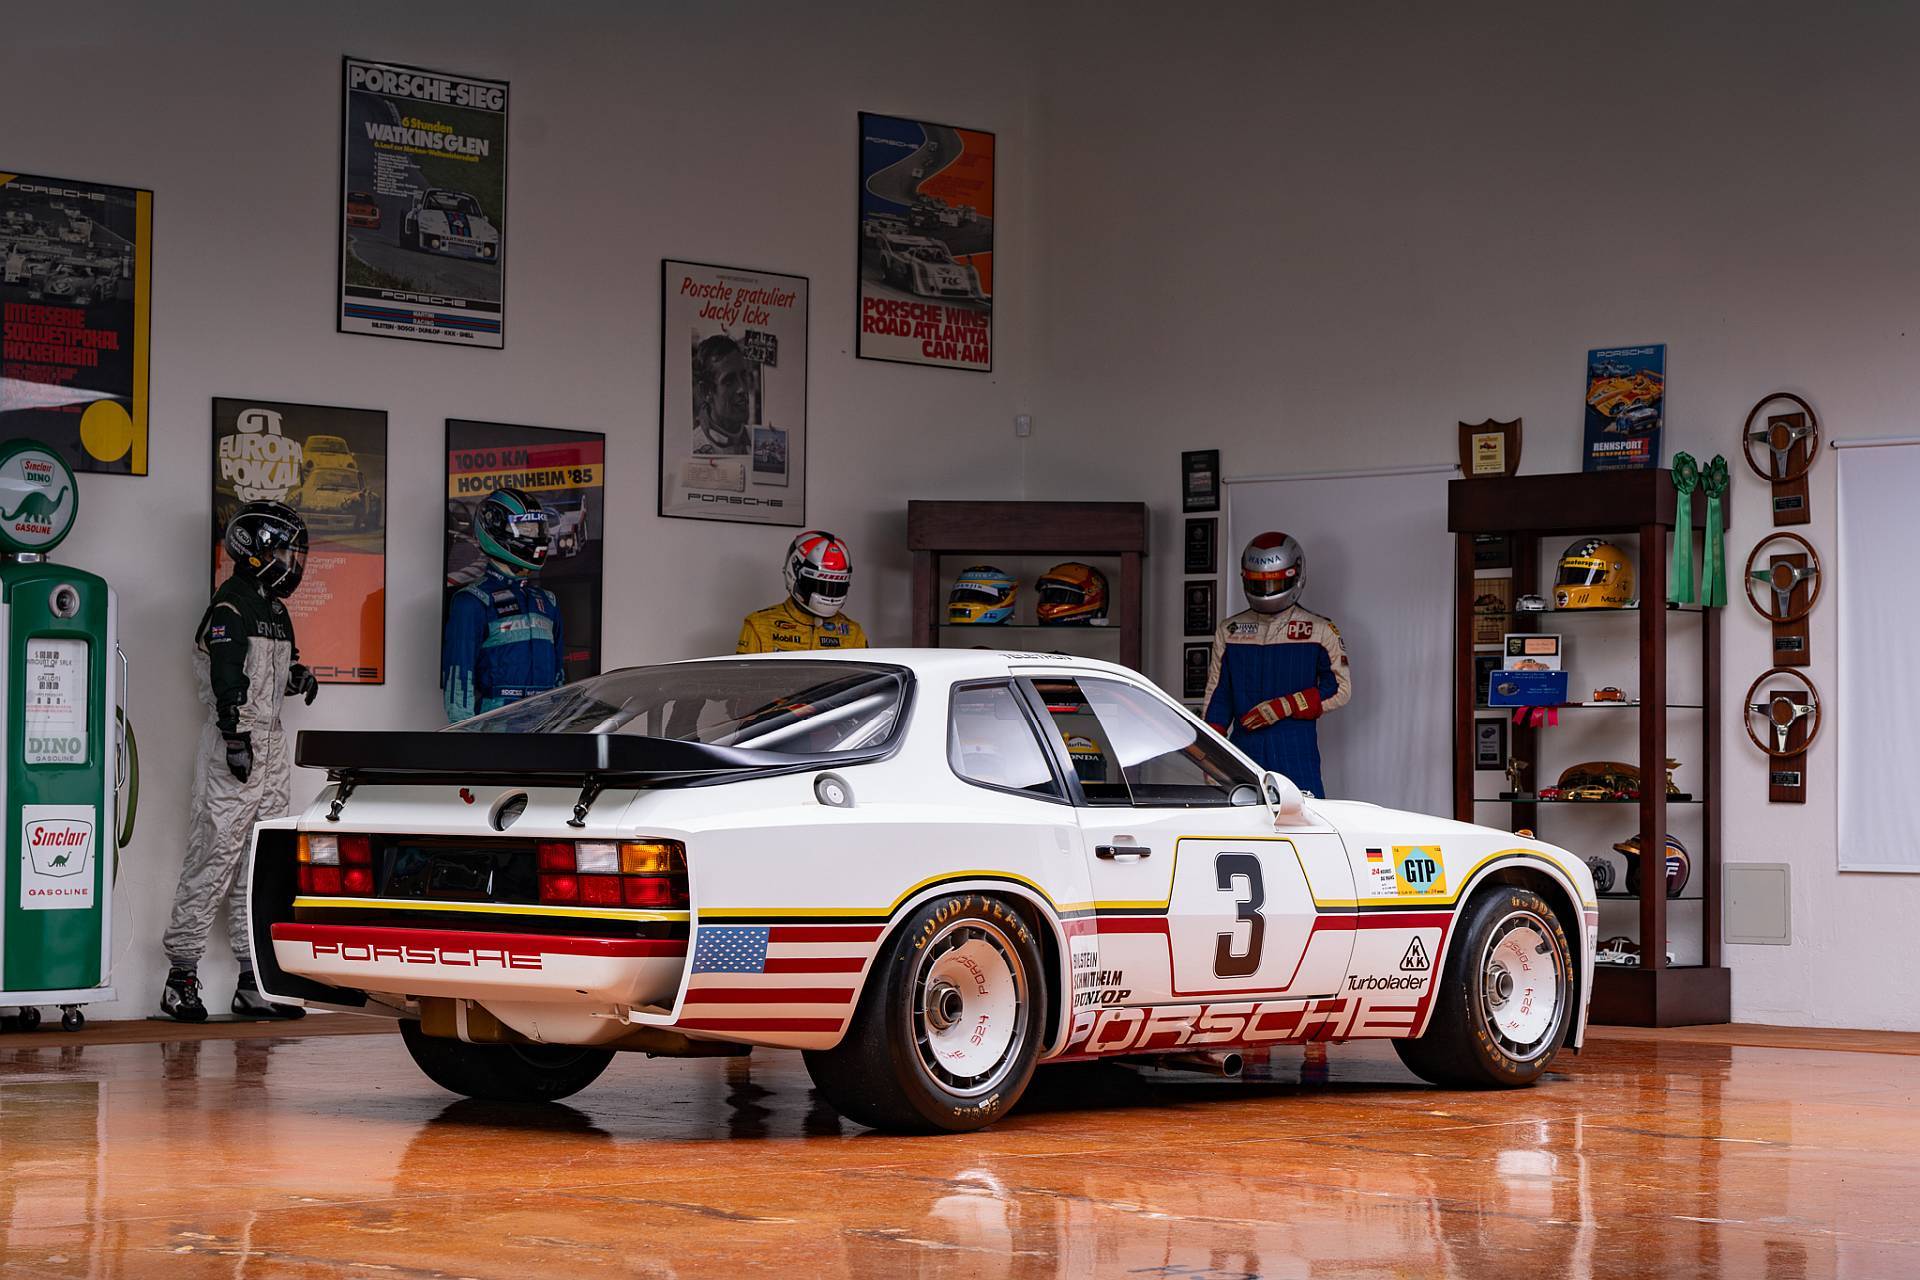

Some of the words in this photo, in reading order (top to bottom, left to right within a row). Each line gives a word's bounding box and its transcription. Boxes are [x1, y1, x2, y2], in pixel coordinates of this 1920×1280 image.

[351, 66, 504, 111] PORSCHE-SIEG
[402, 117, 410, 128] 6
[411, 118, 453, 134] Stunden
[365, 121, 443, 150] WATKINS
[444, 133, 489, 156] GLEN
[864, 137, 920, 149] PORSCHE
[5, 182, 105, 201] PORSCHE
[381, 291, 467, 308] PORSCHE
[680, 277, 733, 301] Porsche
[735, 287, 797, 309] gratuliert
[699, 301, 739, 327] Jacky
[742, 306, 770, 327] Ickx
[863, 297, 942, 323] PORSCHE
[944, 308, 989, 329] WINS
[863, 315, 912, 337] ROAD
[913, 322, 989, 345] ATLANTA
[1597, 348, 1655, 358] PORSCHE
[237, 408, 283, 436] GT
[220, 433, 304, 465] EUROPA
[1593, 440, 1643, 451] RENNSPORT
[25, 461, 52, 473] Sinclair
[455, 452, 497, 470] 1000
[502, 448, 530, 467] KM
[27, 472, 51, 482] DINO
[221, 459, 301, 489] POKAL
[458, 470, 566, 493] HOCKENHEIM
[688, 492, 784, 508] PORSCHE
[15, 523, 52, 535] GASOLINE
[772, 633, 793, 642] Mobil
[1288, 621, 1313, 638] PPG
[28, 737, 82, 754] DINO
[32, 826, 88, 847] Sinclair
[1404, 859, 1436, 883] GTP
[28, 888, 89, 896] GASOLINE
[1213, 852, 1266, 979] 3
[312, 941, 544, 971] PORSCHE
[1073, 951, 1098, 969] BILSTEIN
[1347, 973, 1428, 991] Turbolader
[1073, 989, 1132, 1008] DUNLOP
[1066, 997, 1421, 1052] PORSCHE
